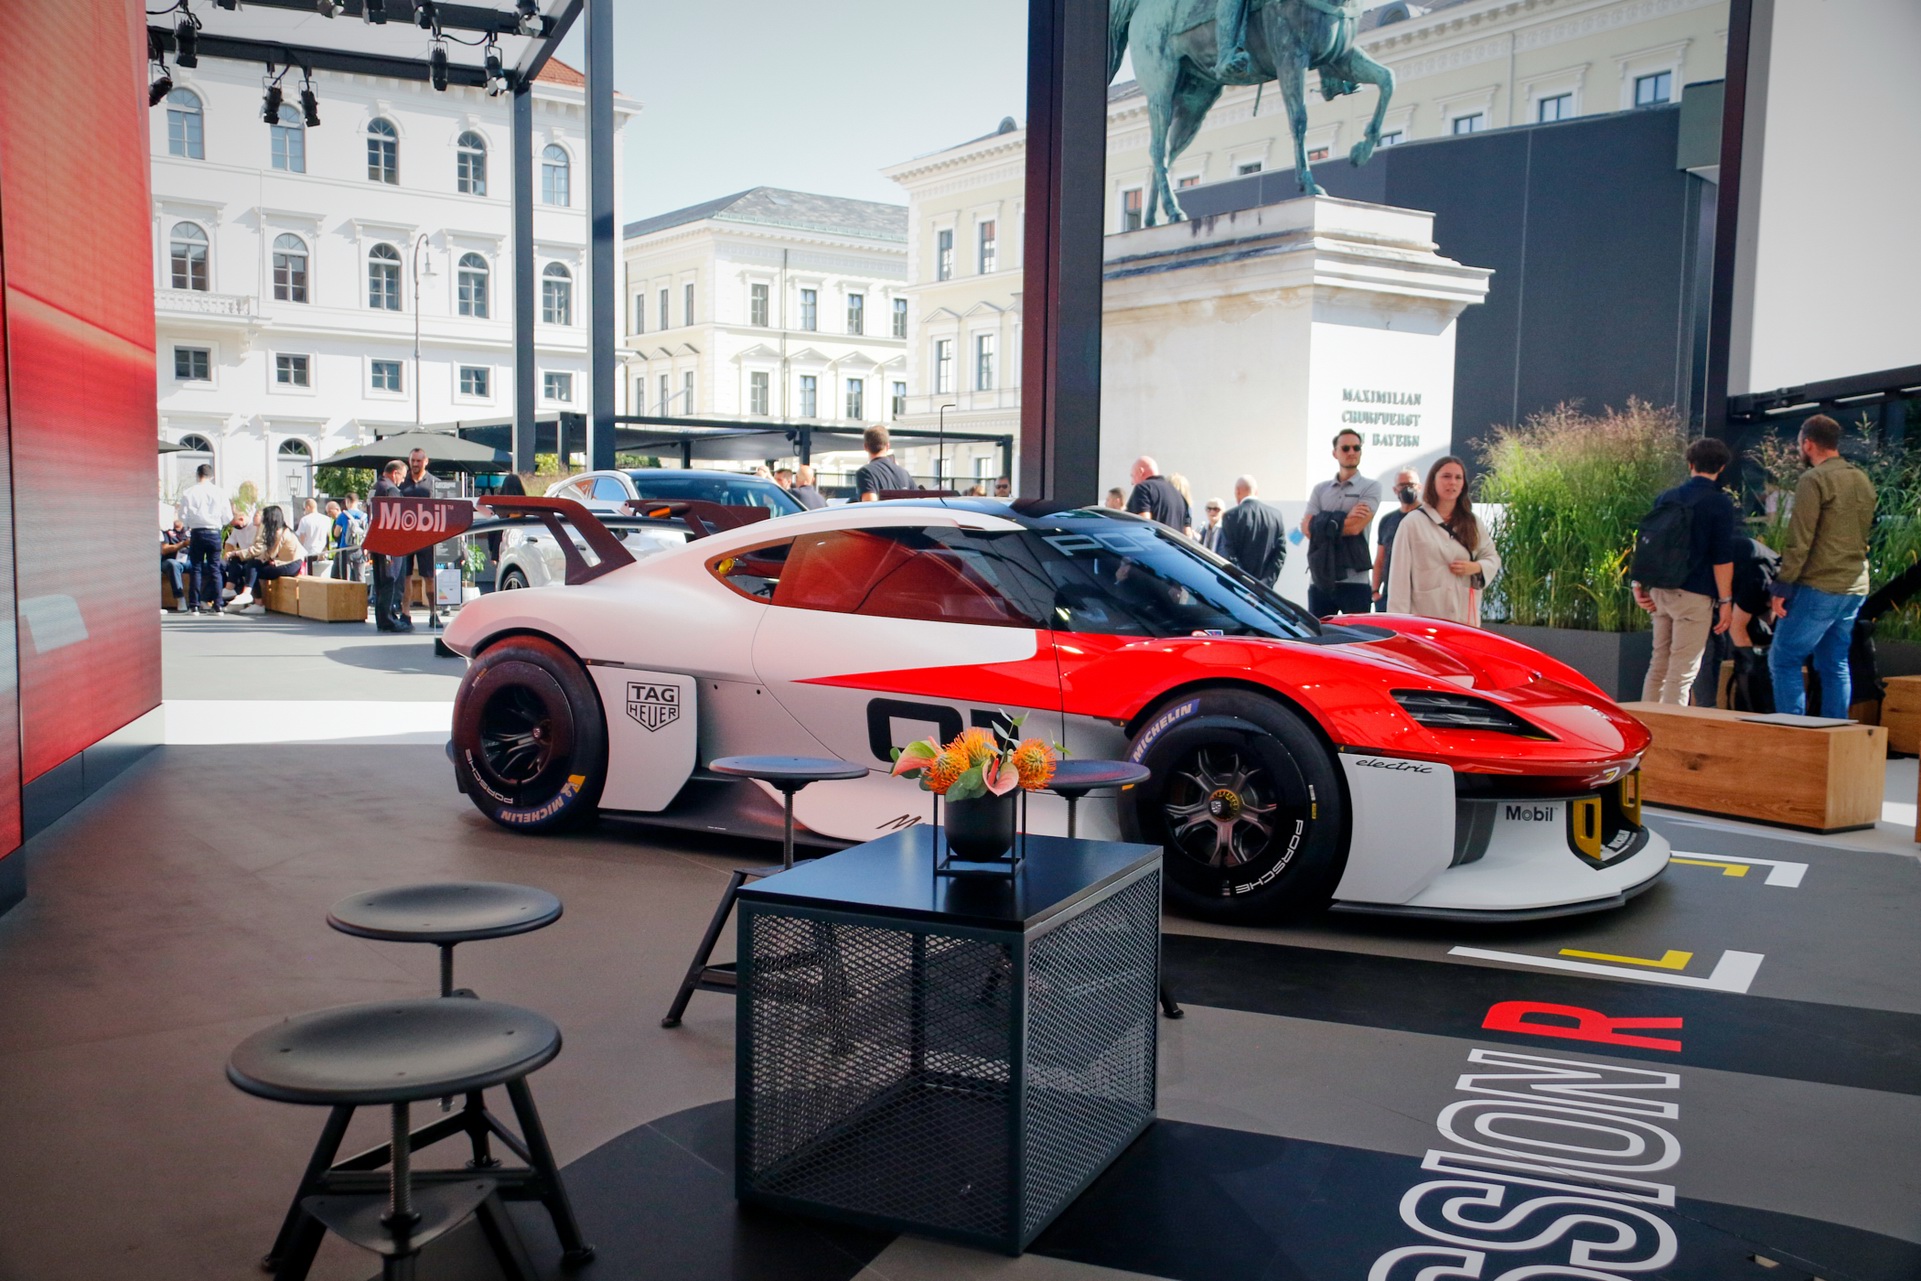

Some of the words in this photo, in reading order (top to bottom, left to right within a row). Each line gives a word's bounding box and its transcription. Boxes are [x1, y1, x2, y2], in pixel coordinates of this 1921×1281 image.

[1342, 388, 1422, 406] MAXIMILIAN
[1371, 433, 1420, 448] BAYERN
[378, 502, 446, 532] Mobil
[631, 685, 675, 703] TAG
[629, 704, 676, 728] HEUER
[1132, 703, 1193, 763] MICHELIN
[465, 749, 514, 805] PORSCHE
[1355, 757, 1434, 775] electric
[501, 795, 565, 823] MICHELIN
[1505, 805, 1553, 822] Mobil
[1235, 818, 1304, 894] PORSCHE
[1481, 1000, 1684, 1053] R
